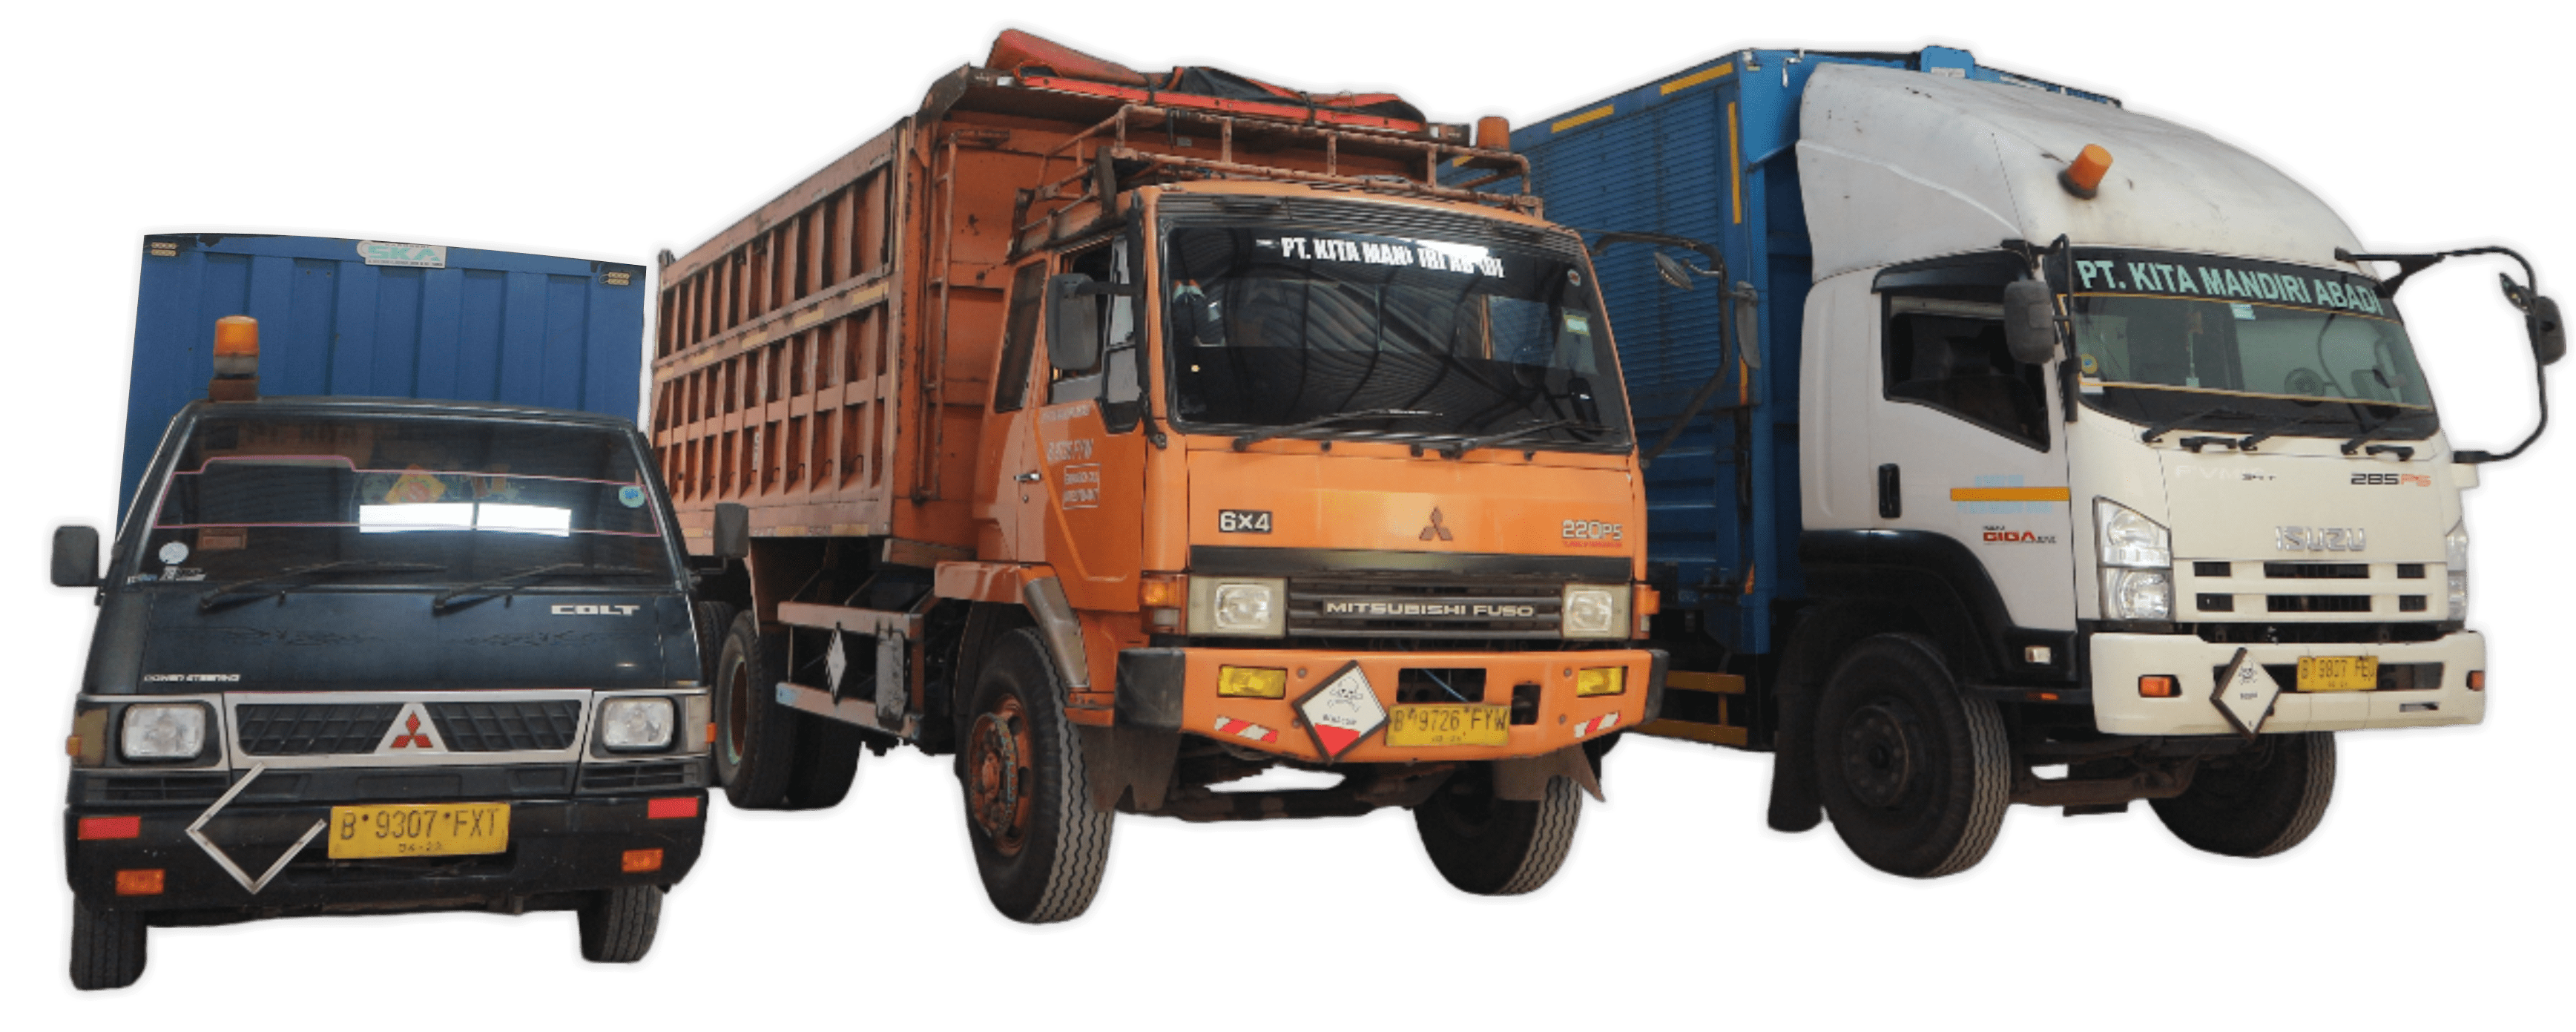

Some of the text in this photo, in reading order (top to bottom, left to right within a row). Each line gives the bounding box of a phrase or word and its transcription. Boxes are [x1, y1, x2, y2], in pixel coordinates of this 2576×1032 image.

[368, 245, 441, 261] SKA
[1312, 238, 1361, 262] KITA
[2075, 260, 2385, 316] PT. KITA MANDIRI ABADI
[1983, 530, 2037, 542] GIGA
[2276, 525, 2366, 551] ISUZU
[551, 605, 641, 617] COLT
[1326, 602, 1535, 617] MITSUBISHI FUSO
[340, 808, 501, 841] B 9307 FXT
